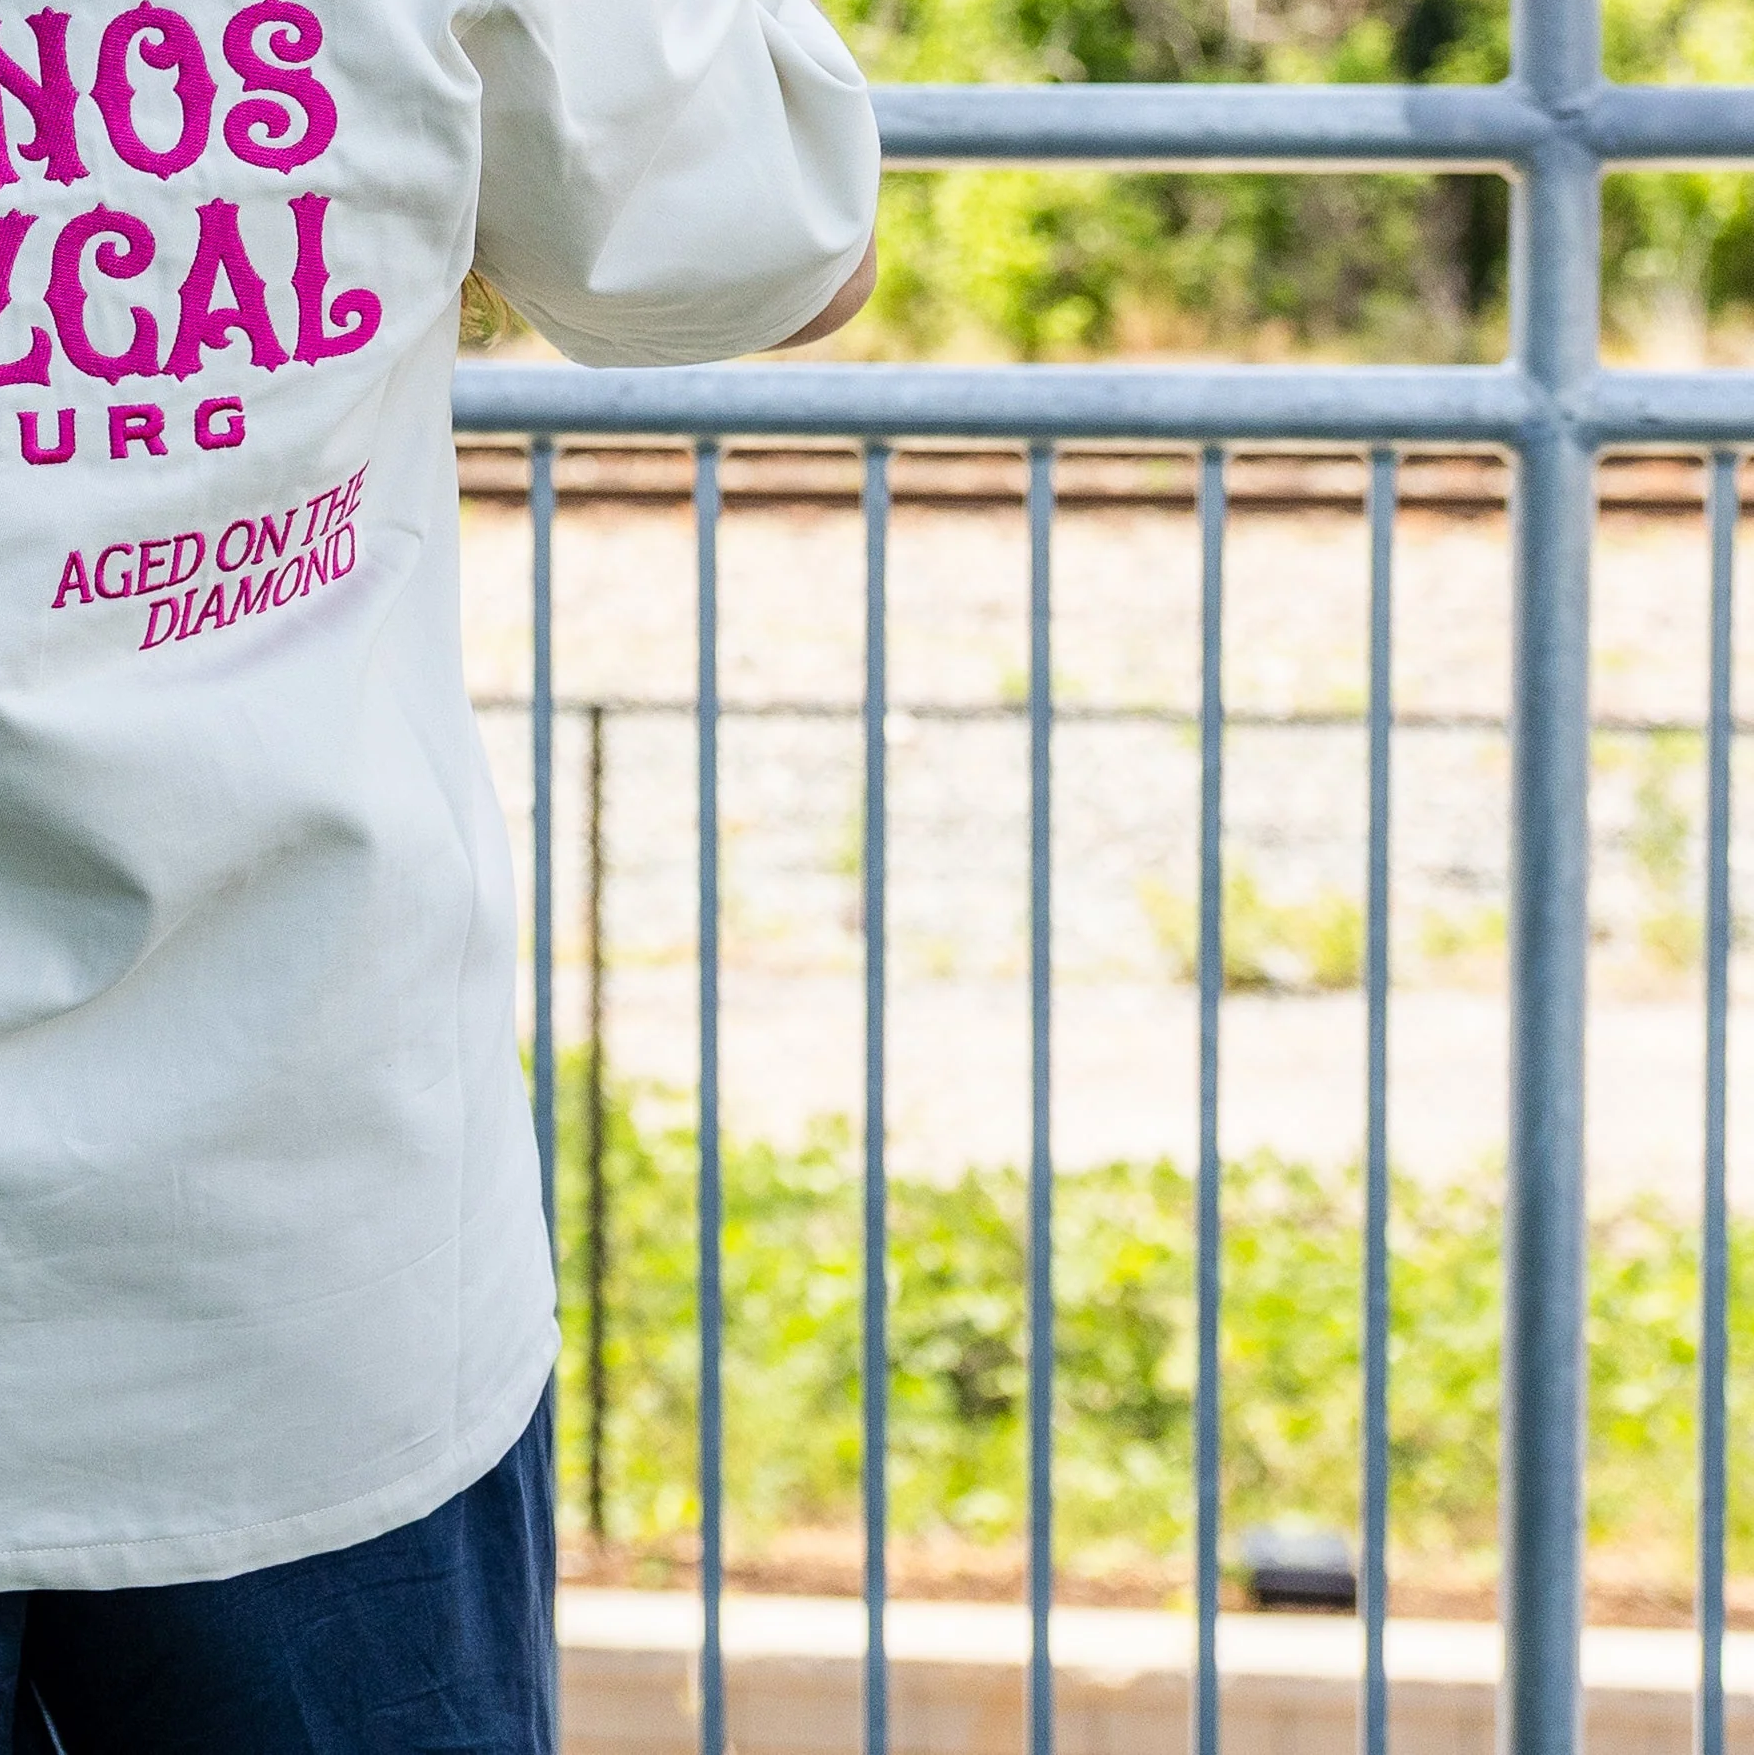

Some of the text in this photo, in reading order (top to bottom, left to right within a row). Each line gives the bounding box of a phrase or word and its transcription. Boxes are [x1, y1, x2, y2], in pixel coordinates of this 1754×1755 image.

[51, 458, 370, 609] AGED ON THE
[139, 520, 356, 651] DIAMOND
